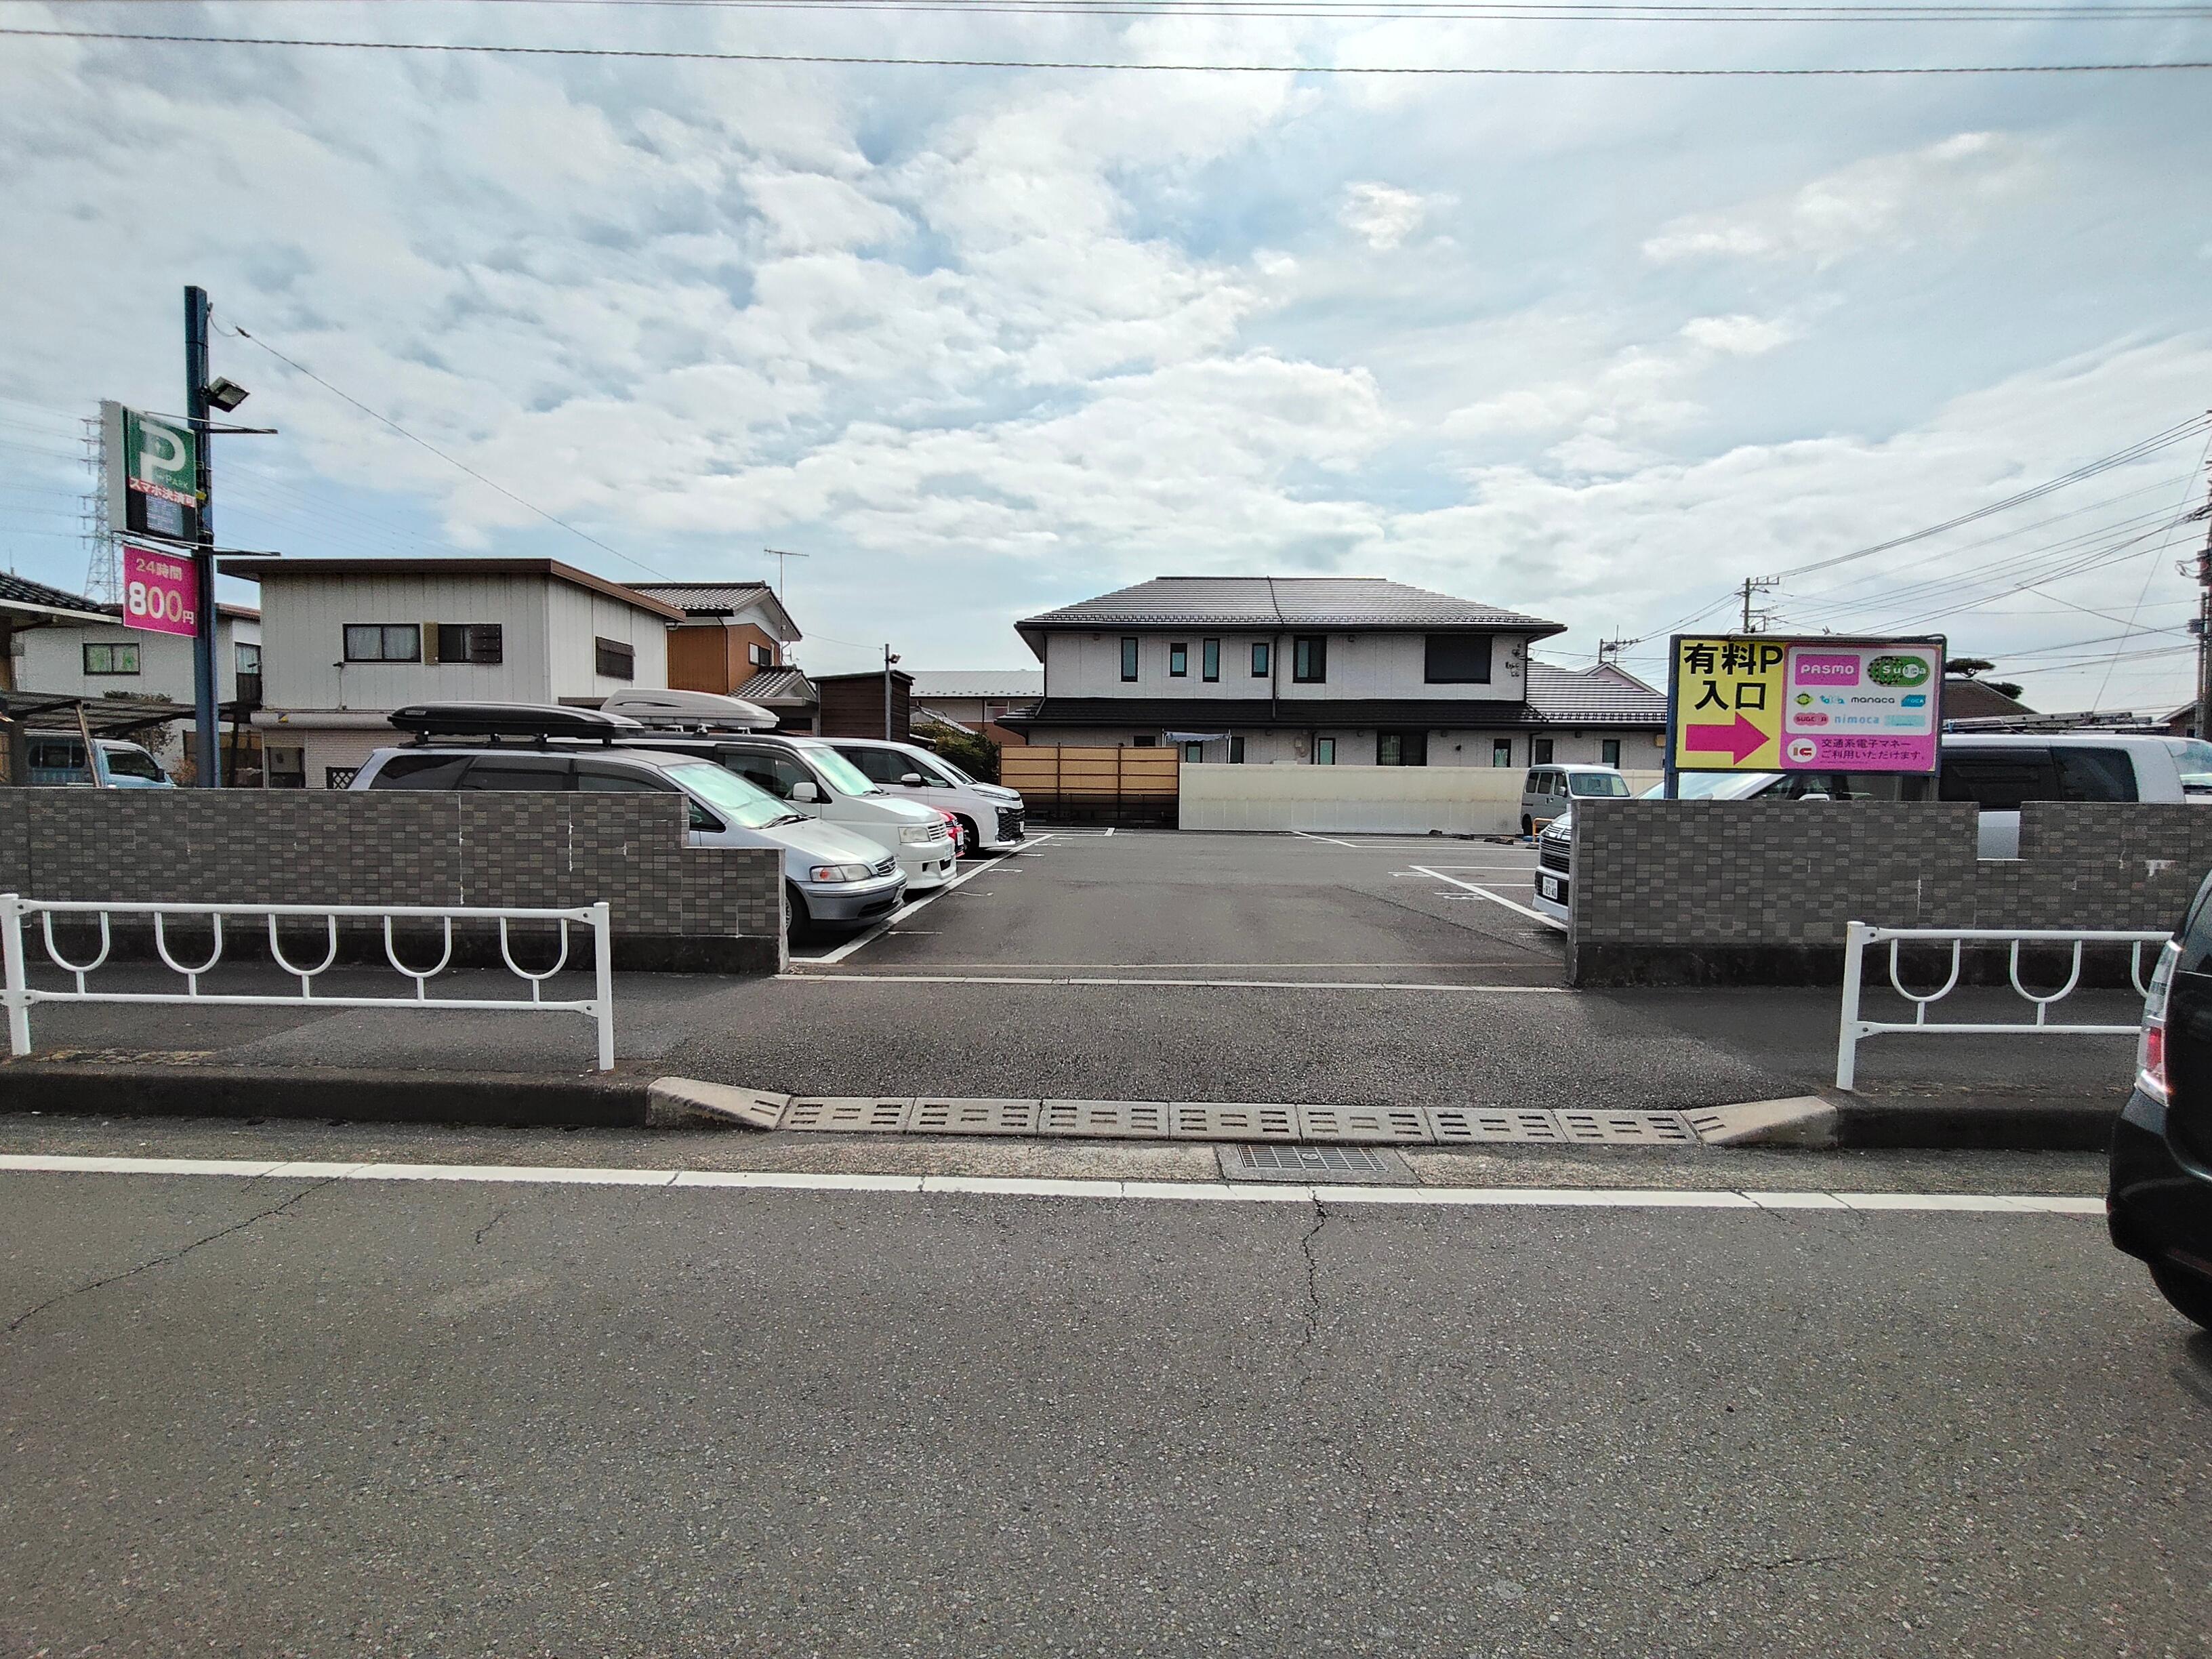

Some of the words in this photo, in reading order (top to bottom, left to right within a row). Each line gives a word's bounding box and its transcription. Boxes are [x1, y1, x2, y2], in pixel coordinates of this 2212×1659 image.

[139, 419, 186, 481] P
[129, 477, 196, 508] スマホ決済可
[136, 557, 183, 581] 24時間
[129, 581, 194, 626] 800円
[1683, 642, 1784, 675] 有料P
[1801, 664, 1855, 674] PASMO
[1694, 680, 1767, 711] 入口
[1834, 714, 1880, 724] nimoca
[1822, 739, 1911, 748] 交通系電子マネー
